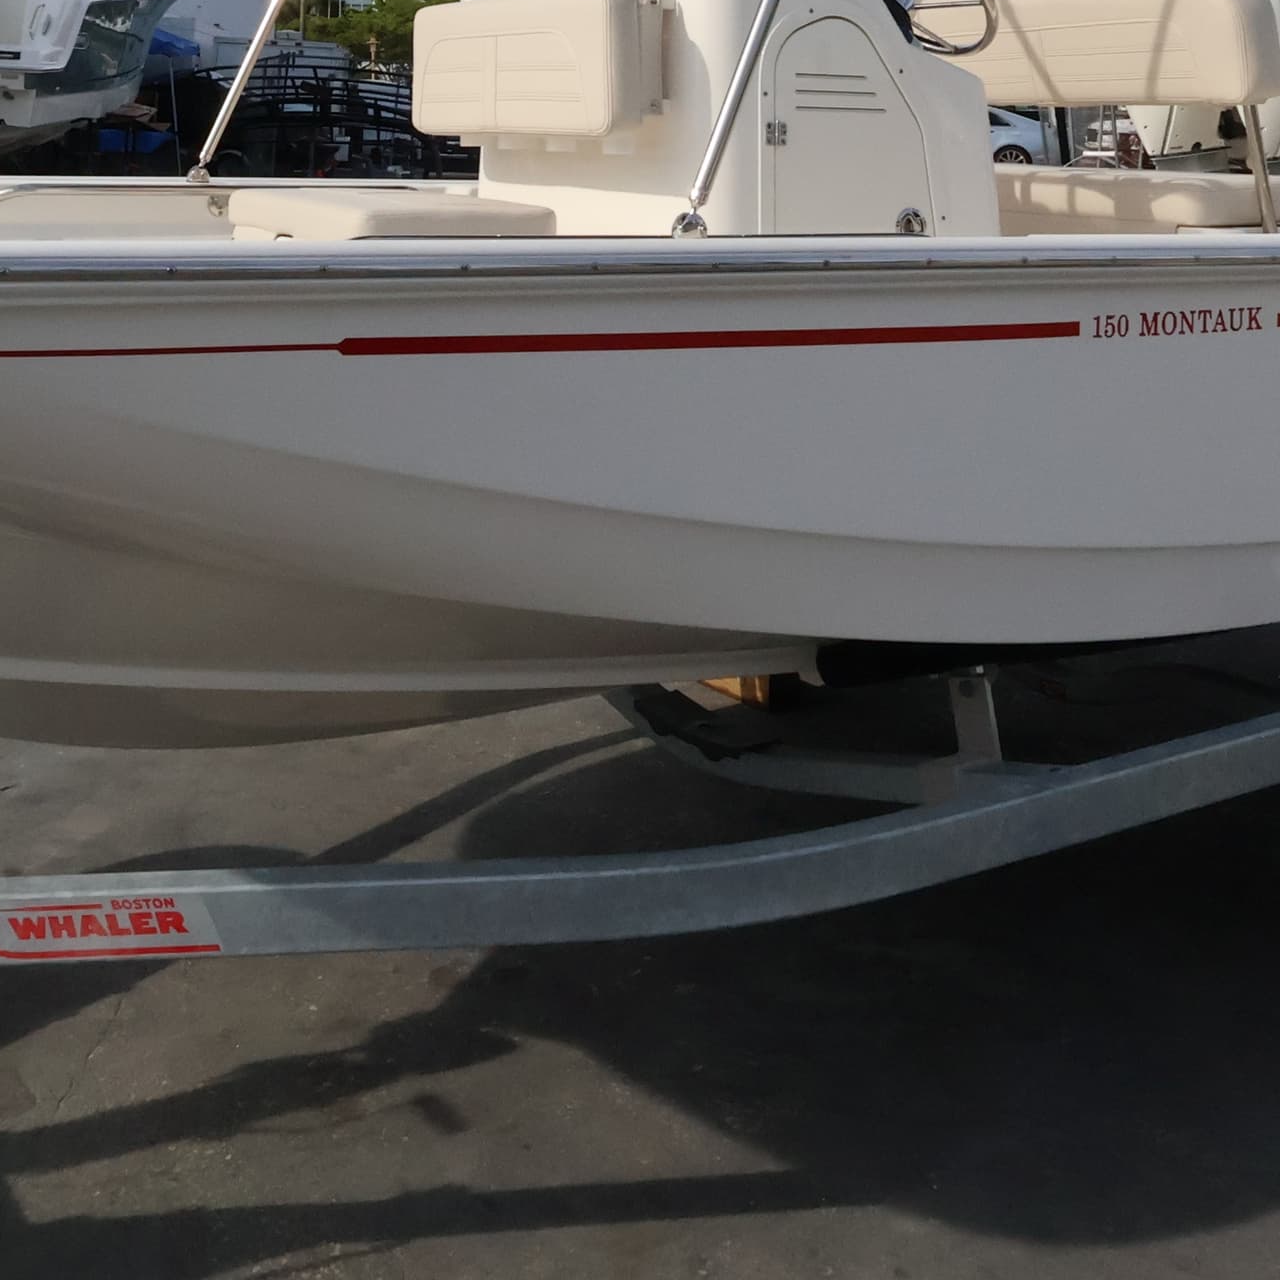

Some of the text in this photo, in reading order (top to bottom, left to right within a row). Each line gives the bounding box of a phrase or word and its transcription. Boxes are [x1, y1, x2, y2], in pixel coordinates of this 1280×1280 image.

[1092, 306, 1264, 339] 150 MONTAUK
[110, 897, 175, 911] BOSTON
[7, 911, 190, 941] WHALER
